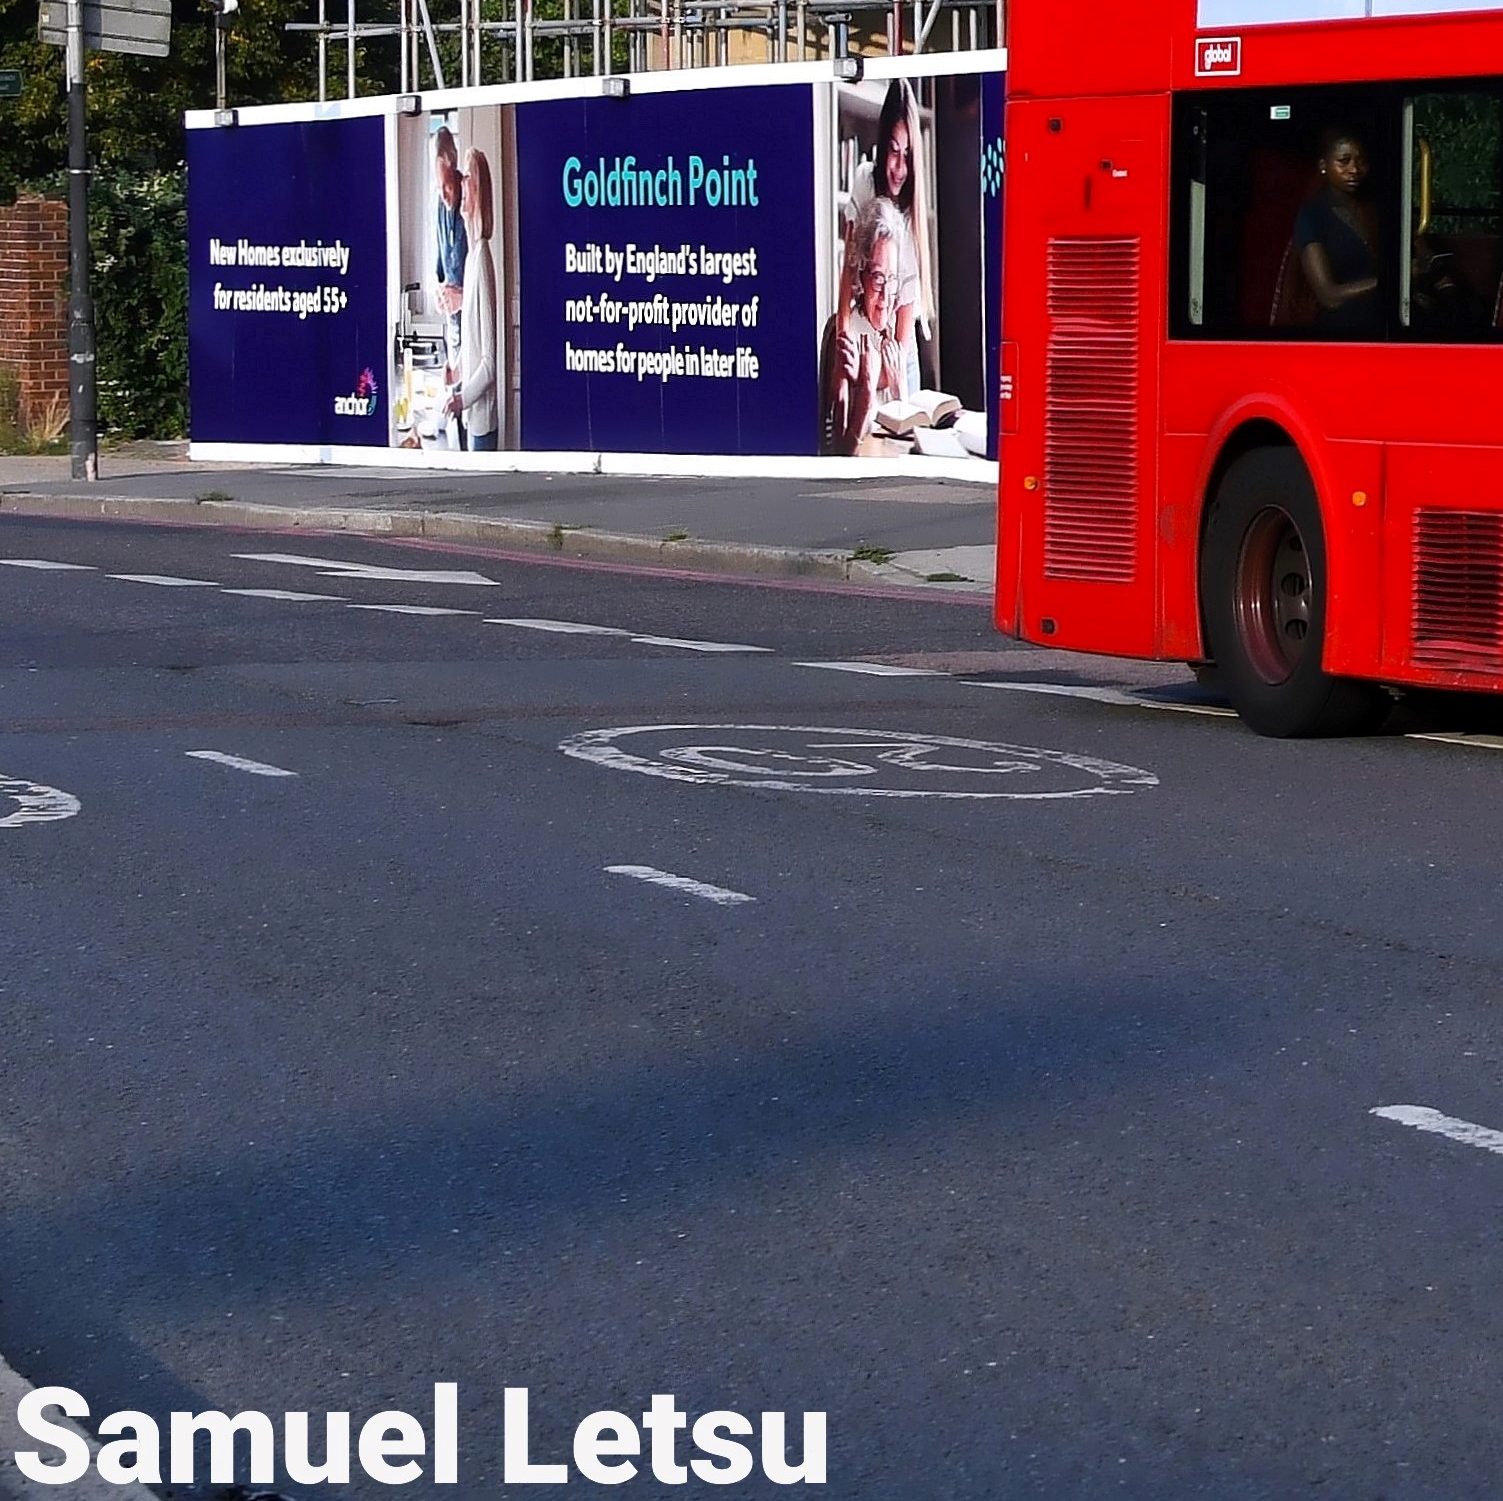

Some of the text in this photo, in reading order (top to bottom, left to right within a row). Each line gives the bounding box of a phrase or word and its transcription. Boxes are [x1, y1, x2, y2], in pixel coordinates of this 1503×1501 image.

[563, 155, 759, 207] Goldfinch Point
[210, 239, 350, 275] New Homes exclusively
[565, 243, 757, 284] Built by England's largest
[214, 282, 348, 319] for residents aged 55+
[565, 293, 759, 332] not-for-profit provider of
[565, 341, 759, 382] homes for people in later life
[334, 392, 369, 416] anchor
